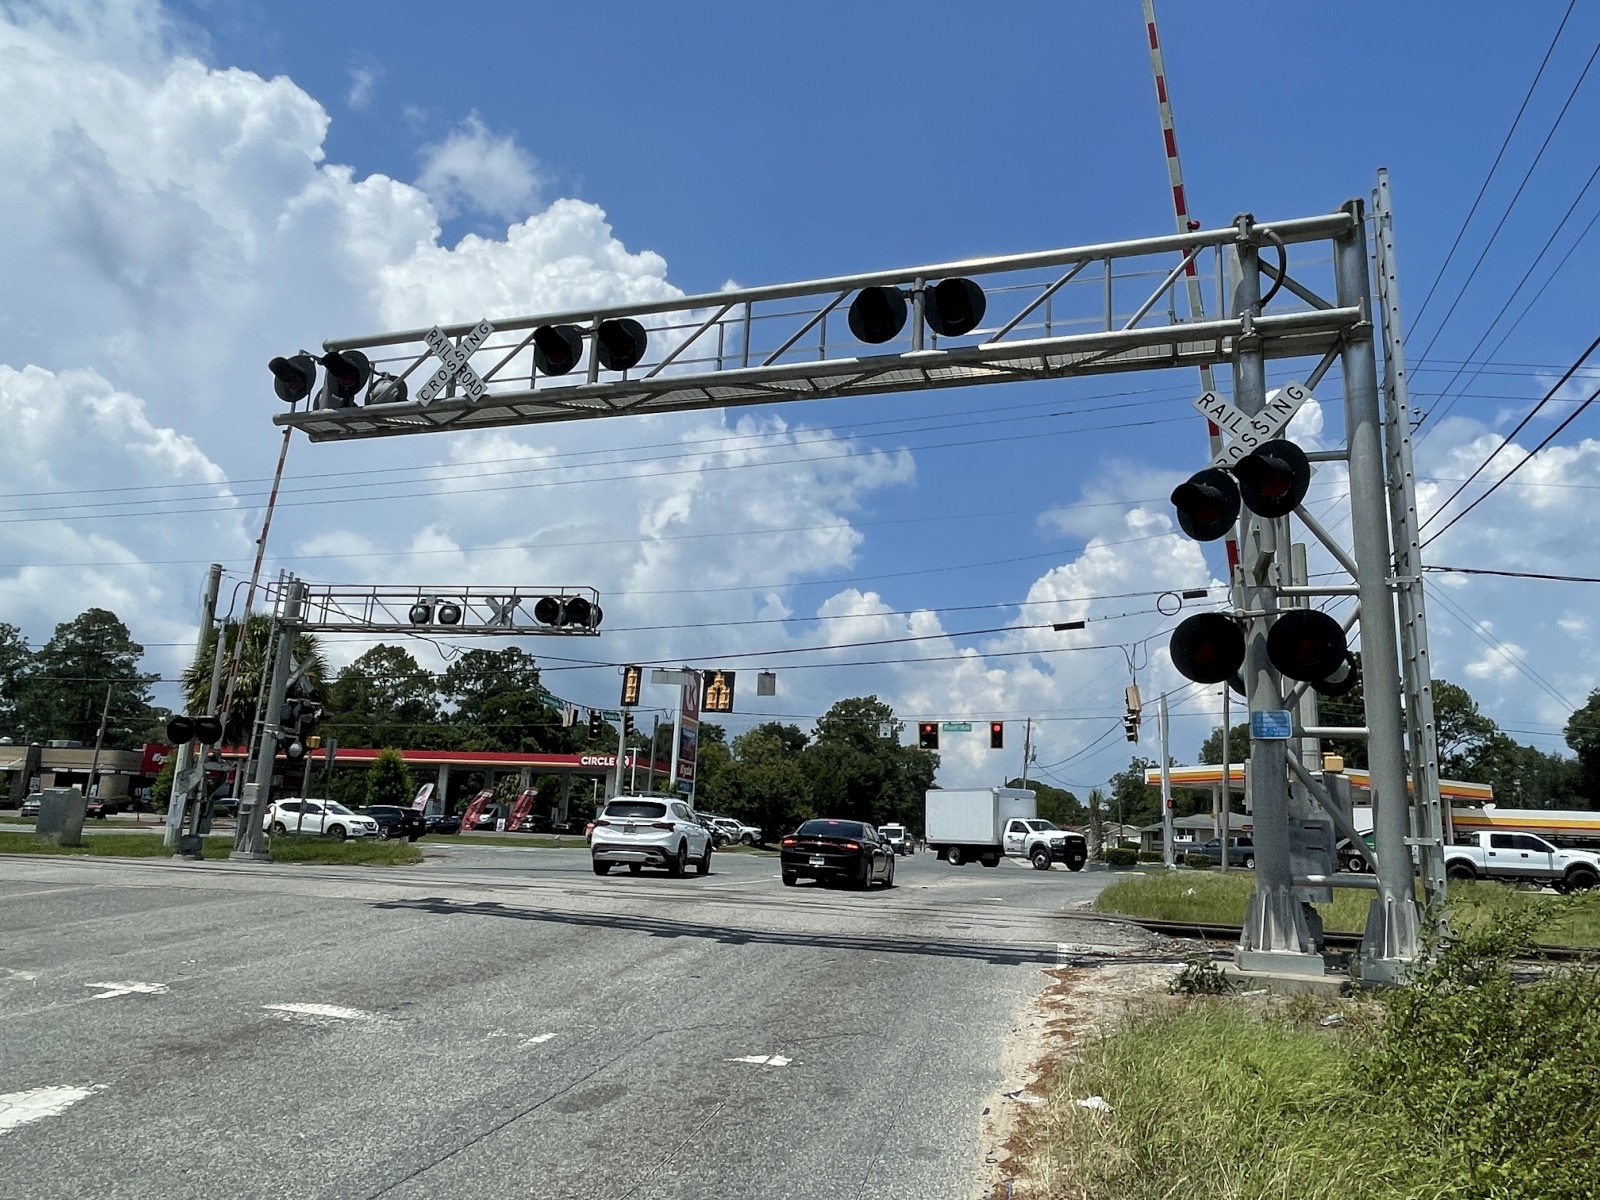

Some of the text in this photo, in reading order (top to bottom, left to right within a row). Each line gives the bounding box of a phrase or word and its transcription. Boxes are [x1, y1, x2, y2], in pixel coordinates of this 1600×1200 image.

[420, 323, 489, 401] CROSSING
[1197, 392, 1243, 434] RAIL
[1215, 386, 1304, 465] OSSING
[581, 756, 615, 767] CIRCLE
